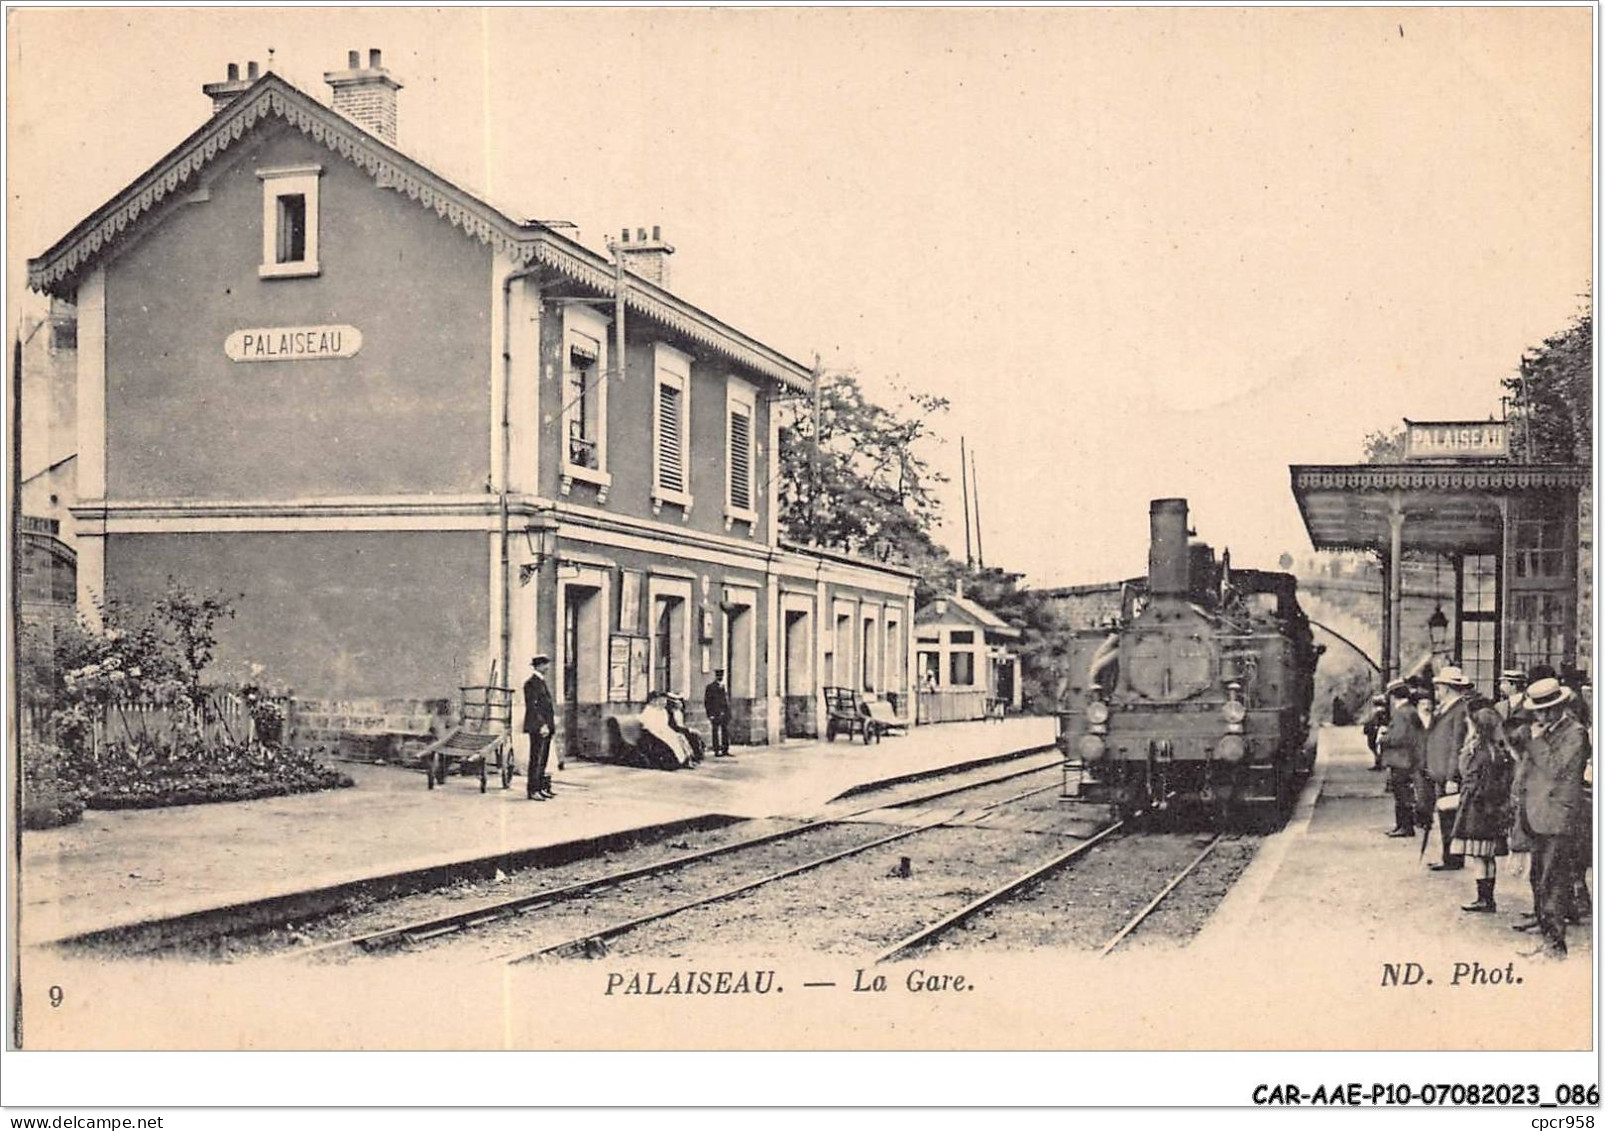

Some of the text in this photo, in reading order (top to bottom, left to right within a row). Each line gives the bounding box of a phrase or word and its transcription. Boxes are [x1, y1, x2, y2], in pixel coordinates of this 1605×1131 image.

[242, 332, 341, 356] PALAISEAU
[1411, 428, 1503, 450] PALAISEAU
[604, 971, 785, 995] PALAISEAU.
[853, 968, 888, 993] La
[905, 968, 975, 994] Gare.
[1381, 961, 1524, 987] ND. Phot.
[48, 985, 64, 1008] 9
